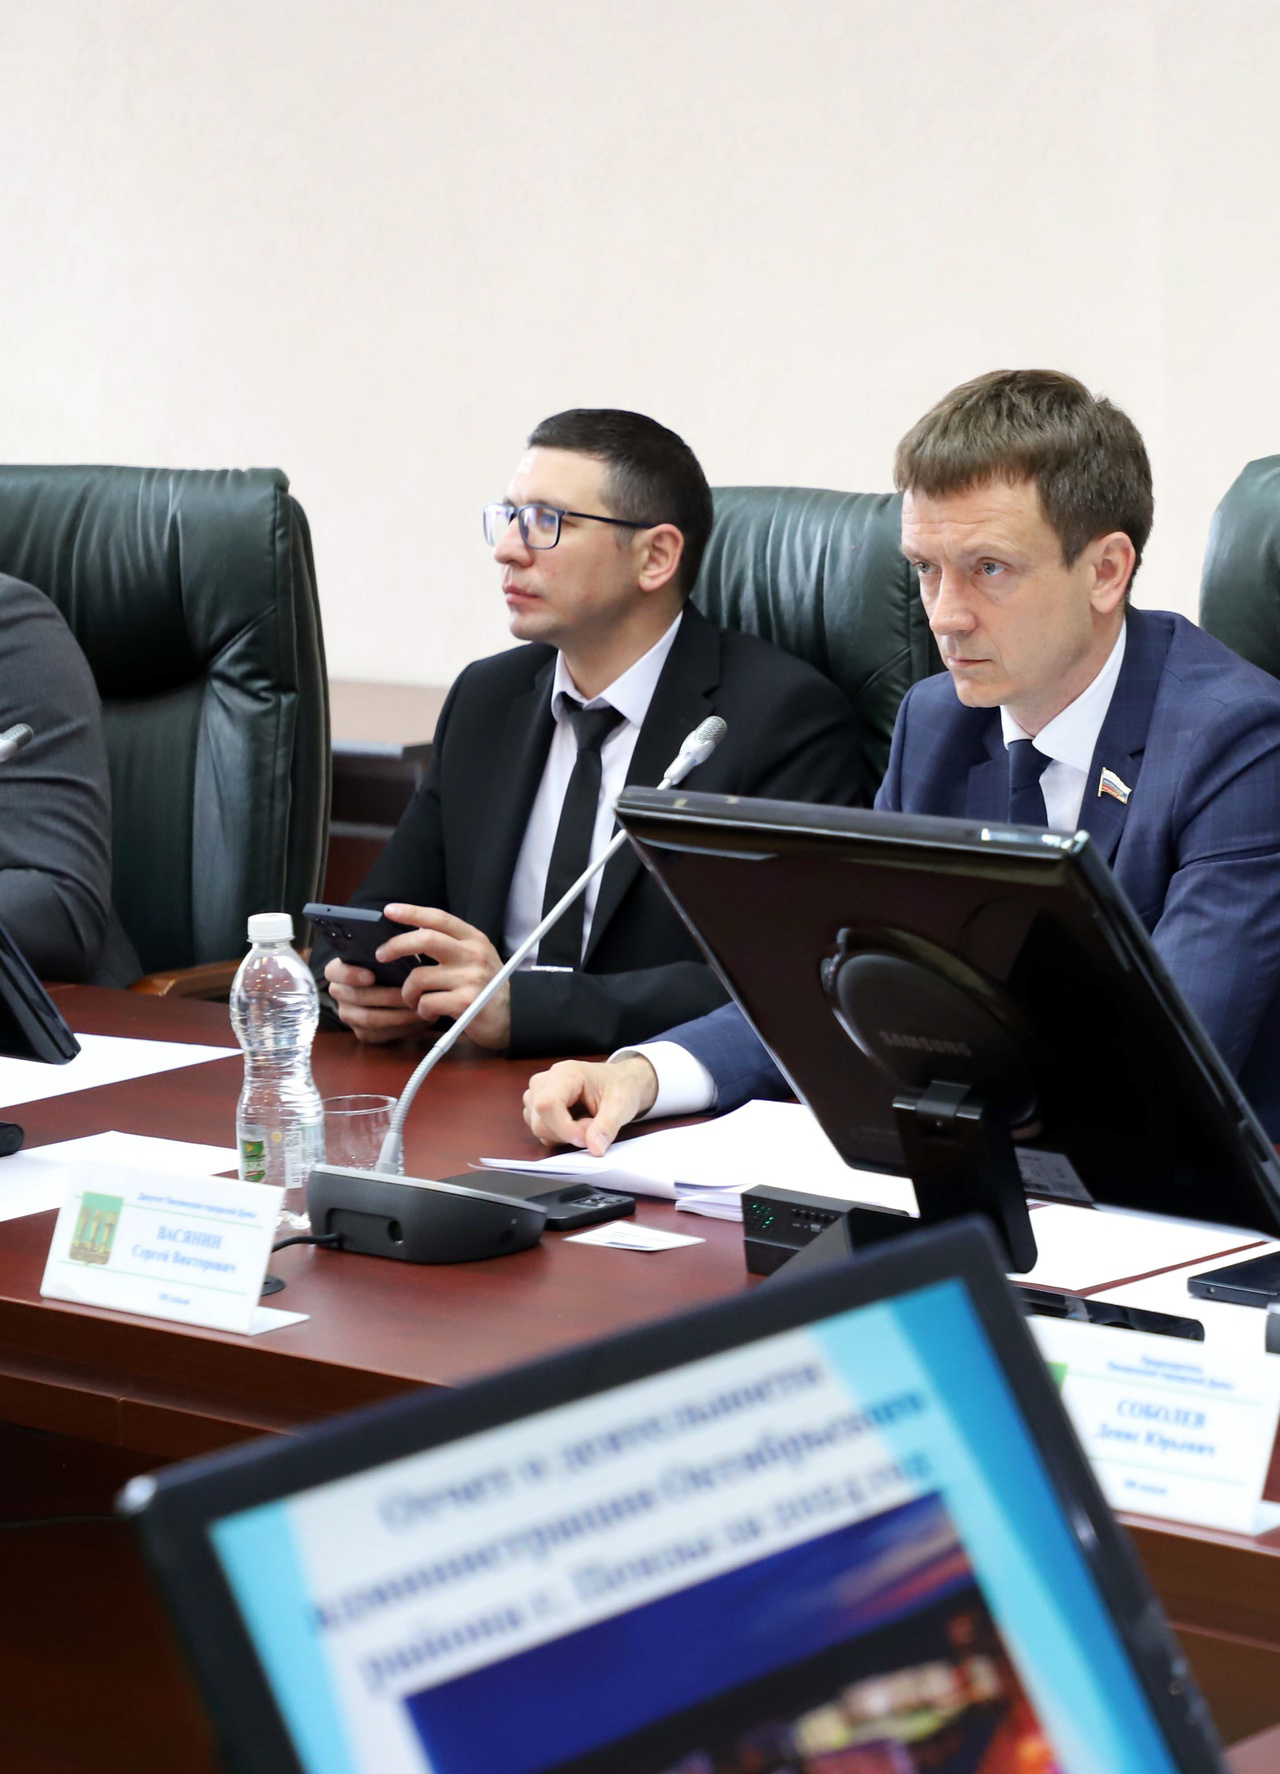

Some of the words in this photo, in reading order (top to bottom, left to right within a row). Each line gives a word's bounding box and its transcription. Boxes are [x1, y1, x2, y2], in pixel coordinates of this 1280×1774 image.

[879, 1030, 972, 1057] SAMSUNG
[157, 1225, 223, 1249] ВАСЯНИН
[132, 1244, 169, 1263] Сергей
[172, 1251, 237, 1274] Викторович
[1117, 1399, 1207, 1430] СОБОЛЕВ
[1096, 1423, 1140, 1445] Денис
[1144, 1430, 1216, 1457] Юрьевич
